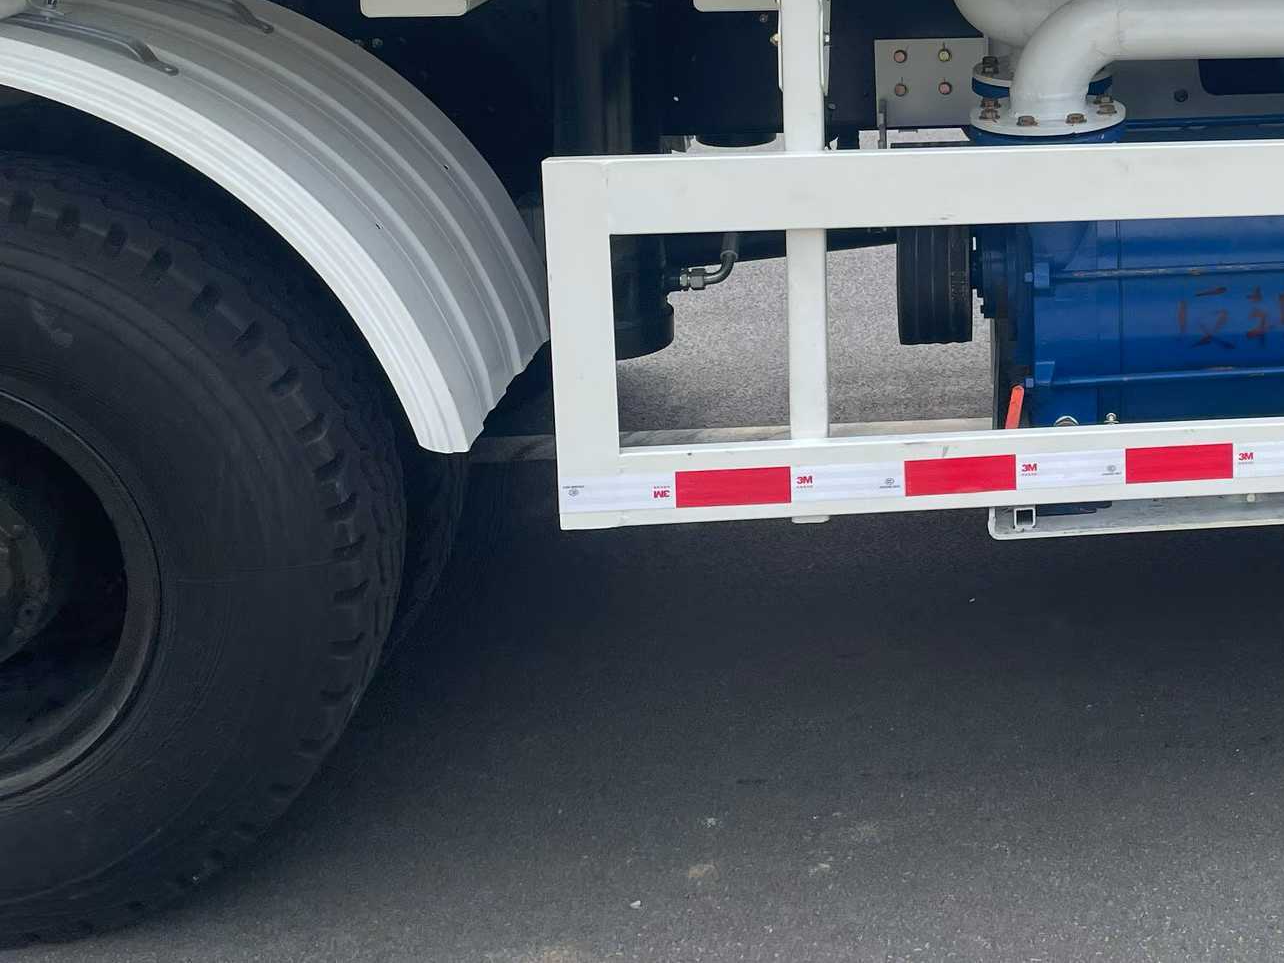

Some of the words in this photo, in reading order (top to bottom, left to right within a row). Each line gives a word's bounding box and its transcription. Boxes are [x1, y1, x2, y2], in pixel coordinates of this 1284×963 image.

[1238, 452, 1253, 460] 3M
[1021, 463, 1037, 472] 3M
[796, 476, 813, 484] 3M
